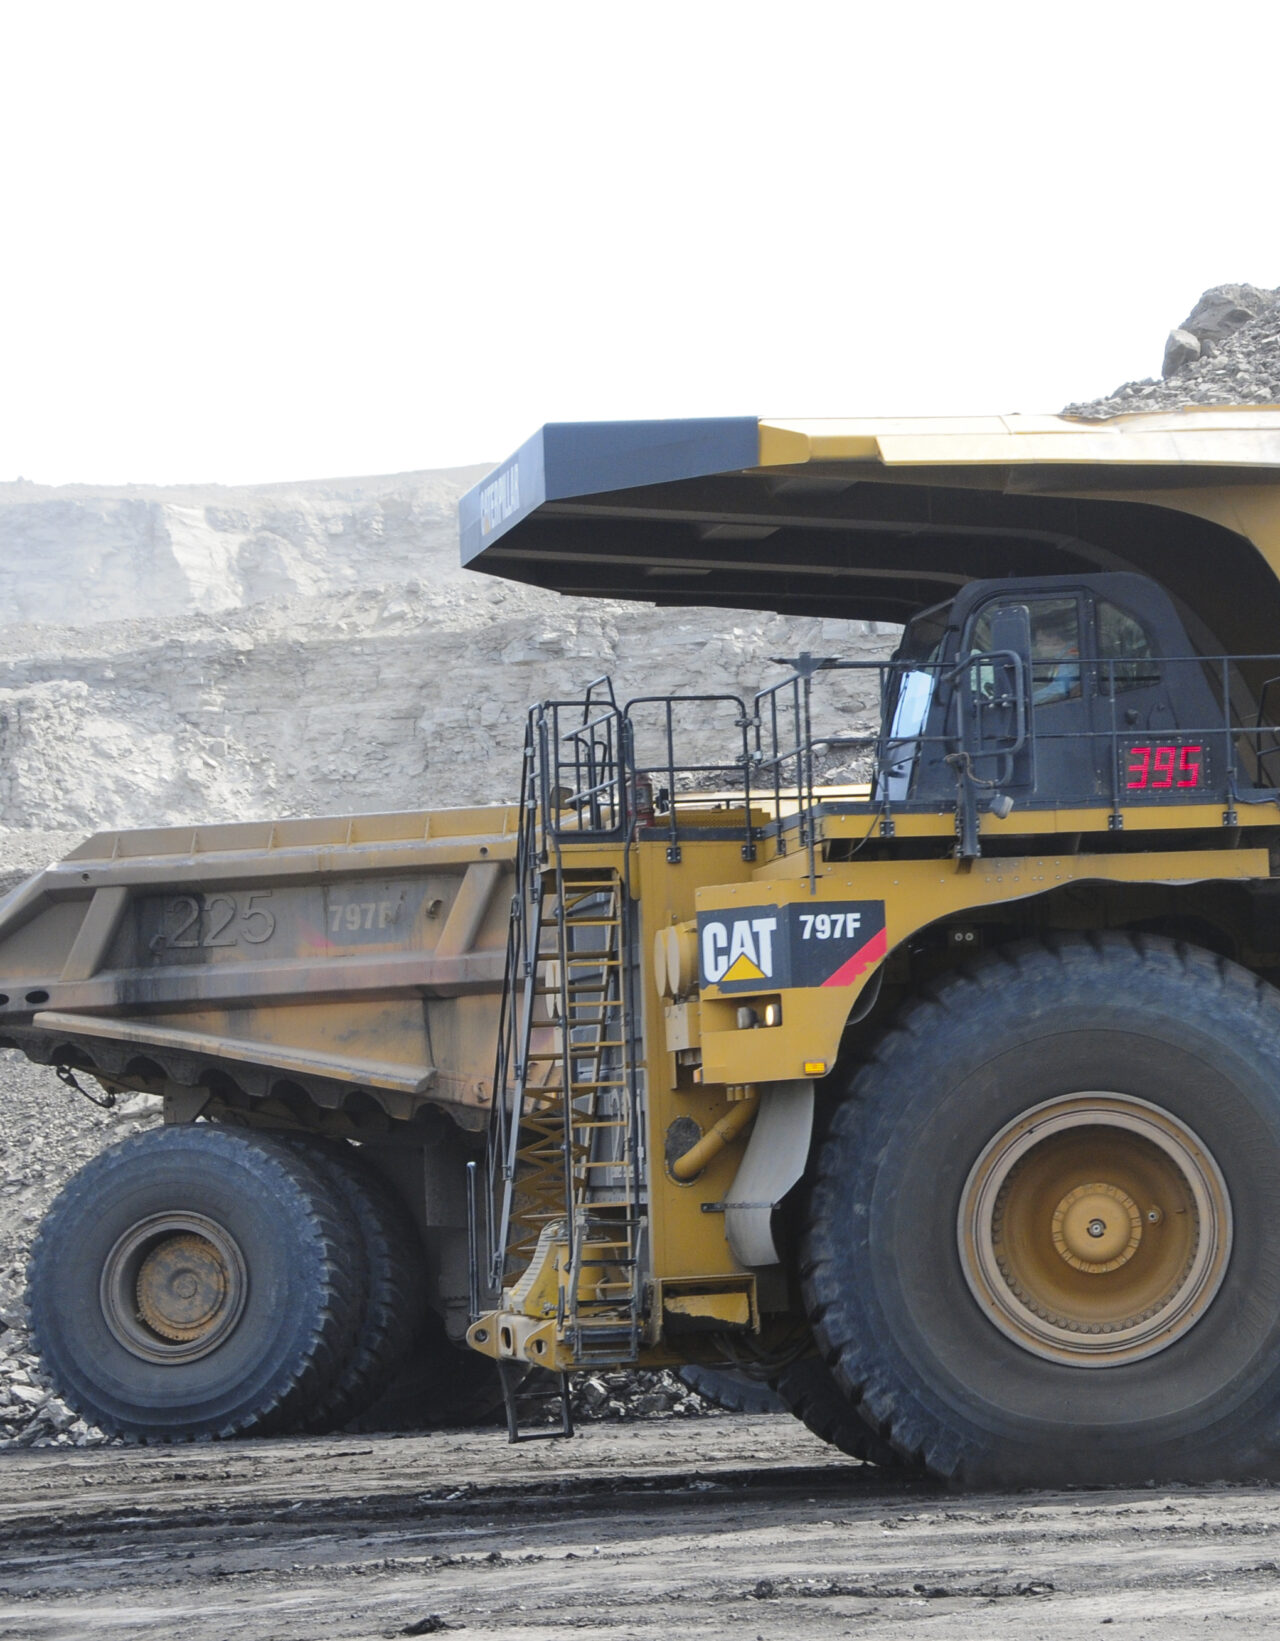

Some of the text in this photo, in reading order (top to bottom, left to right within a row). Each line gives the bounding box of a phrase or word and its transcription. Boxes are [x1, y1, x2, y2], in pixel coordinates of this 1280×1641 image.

[1126, 745, 1202, 788] 395
[165, 889, 277, 950] 225
[799, 912, 862, 940] 797F
[702, 917, 778, 984] CAT
